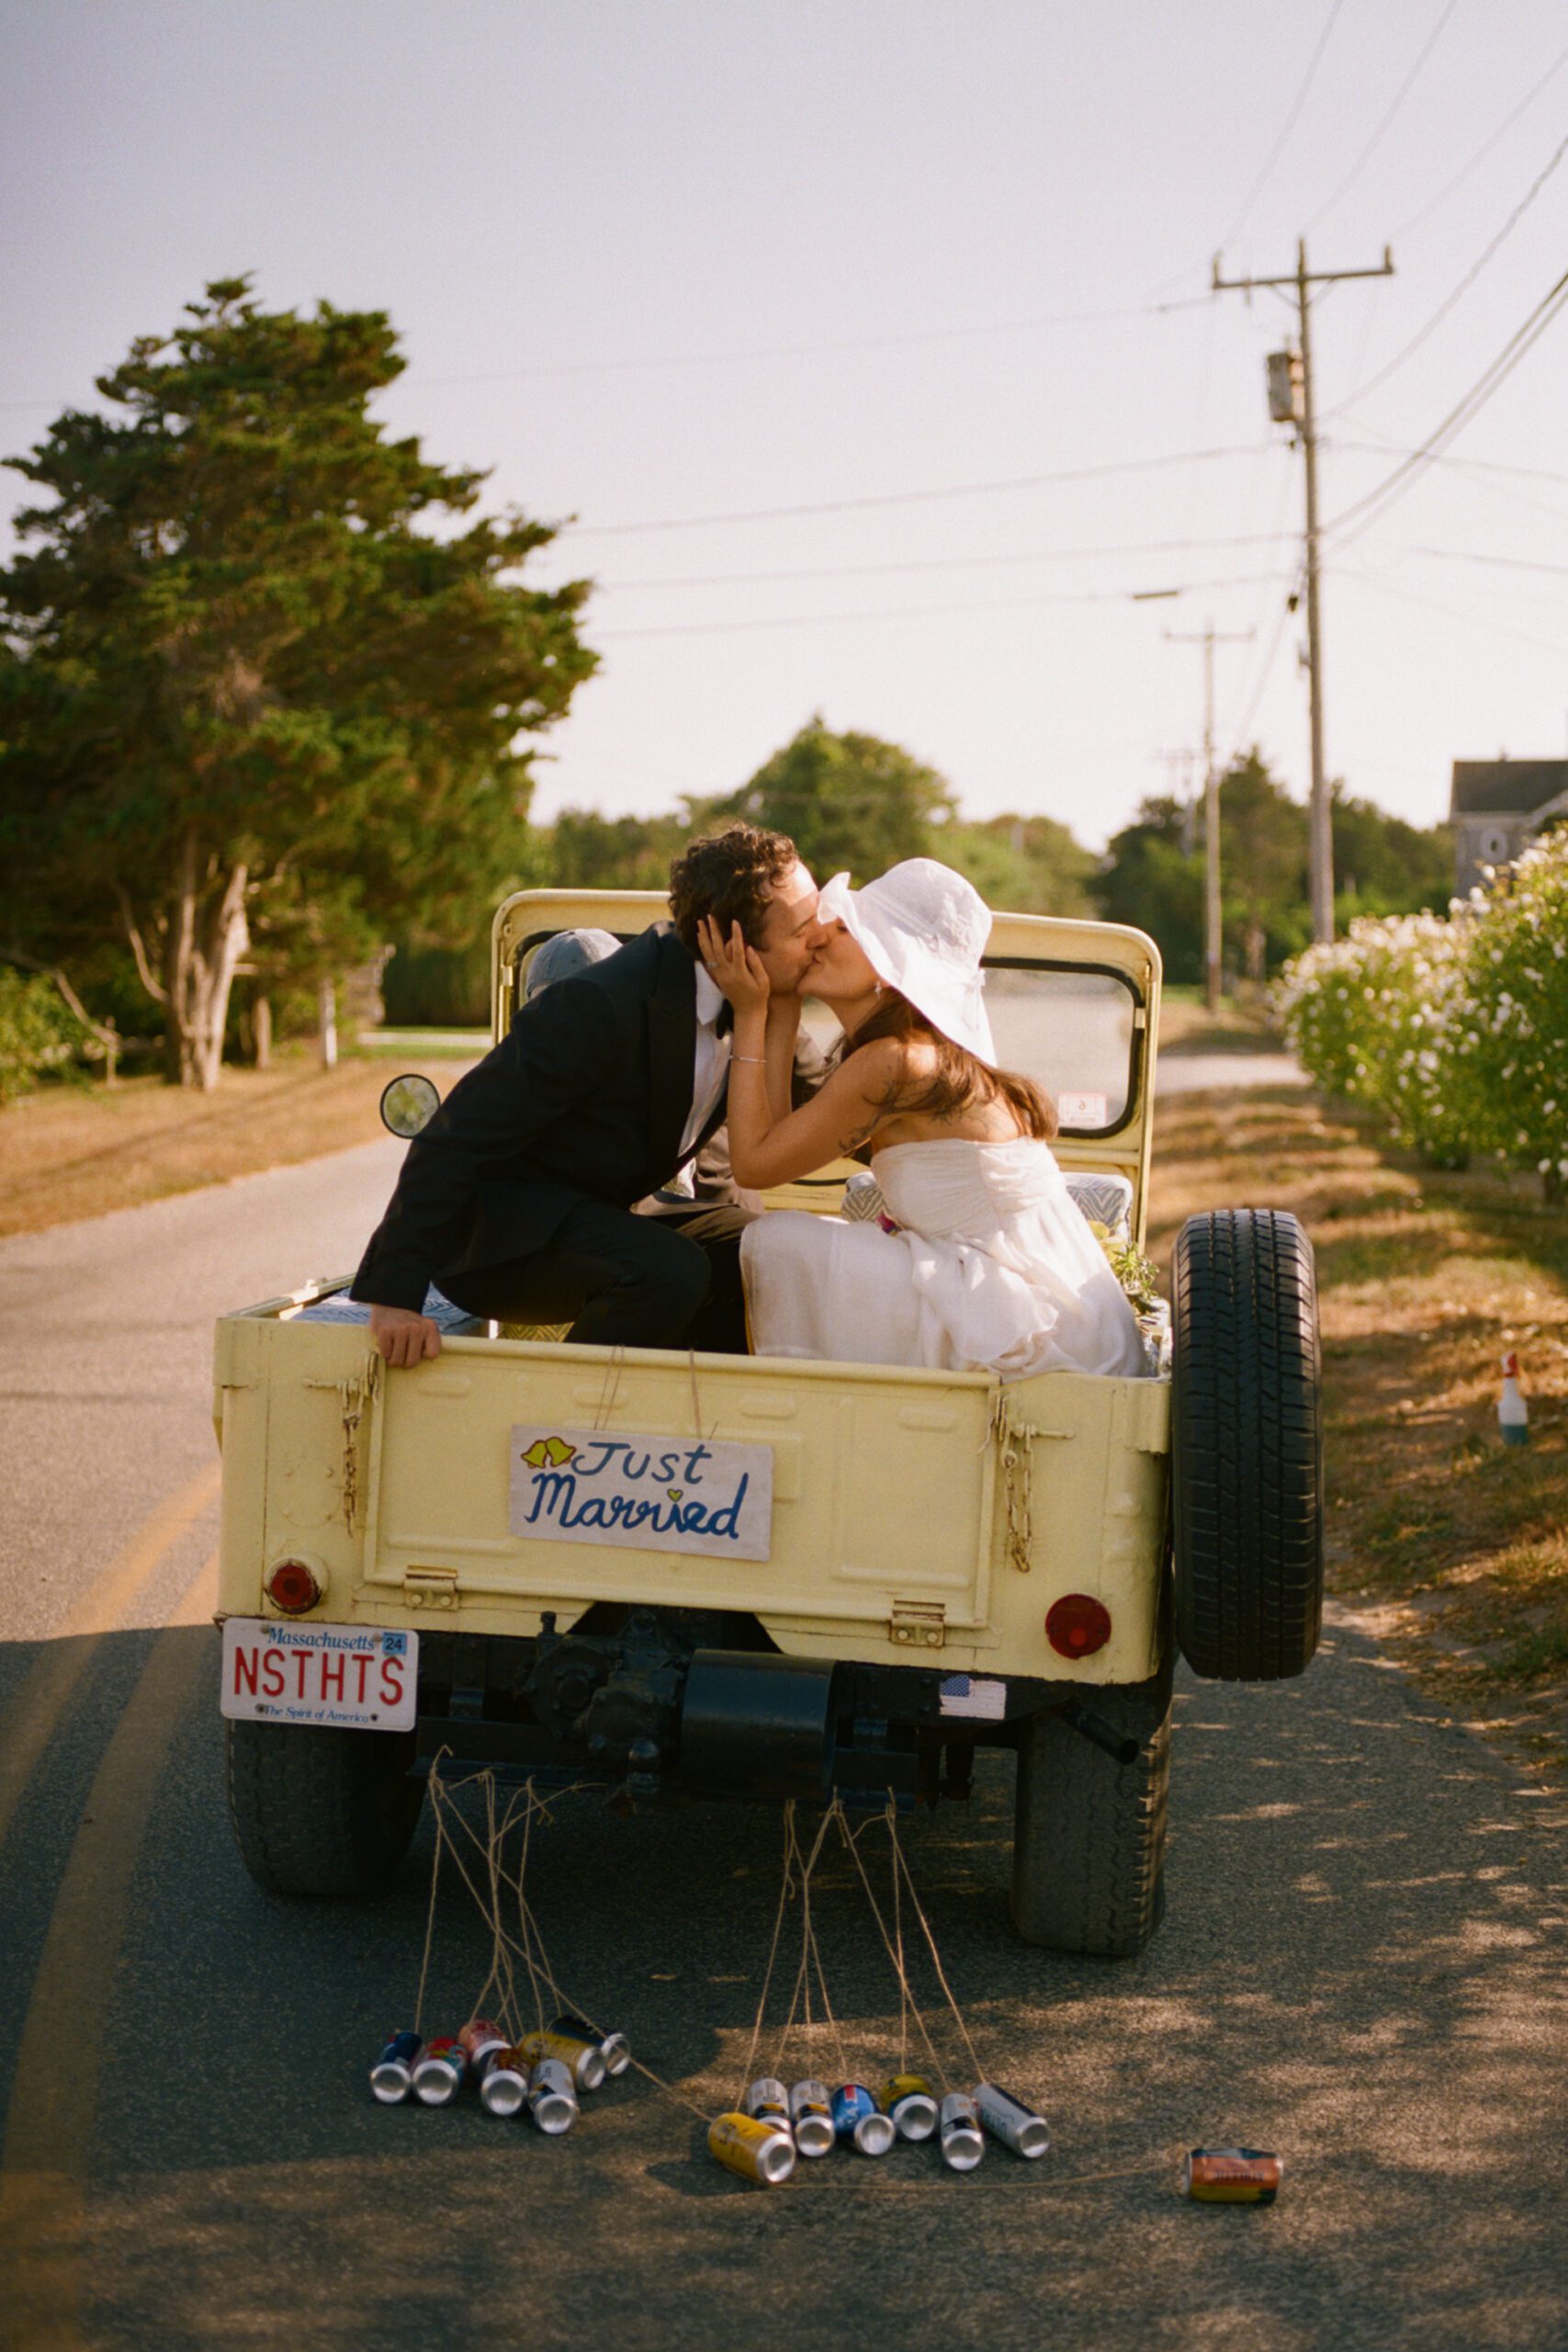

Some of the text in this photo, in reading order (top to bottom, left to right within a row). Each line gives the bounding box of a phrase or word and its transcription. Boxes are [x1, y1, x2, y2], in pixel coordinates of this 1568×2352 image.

[570, 1442, 713, 1485] Just
[524, 1472, 749, 1540] Married
[268, 1627, 375, 1651] Massachusetts
[385, 1637, 402, 1651] 24
[234, 1646, 404, 1706] NSTHTS
[265, 1704, 368, 1724] The Spirit of America
